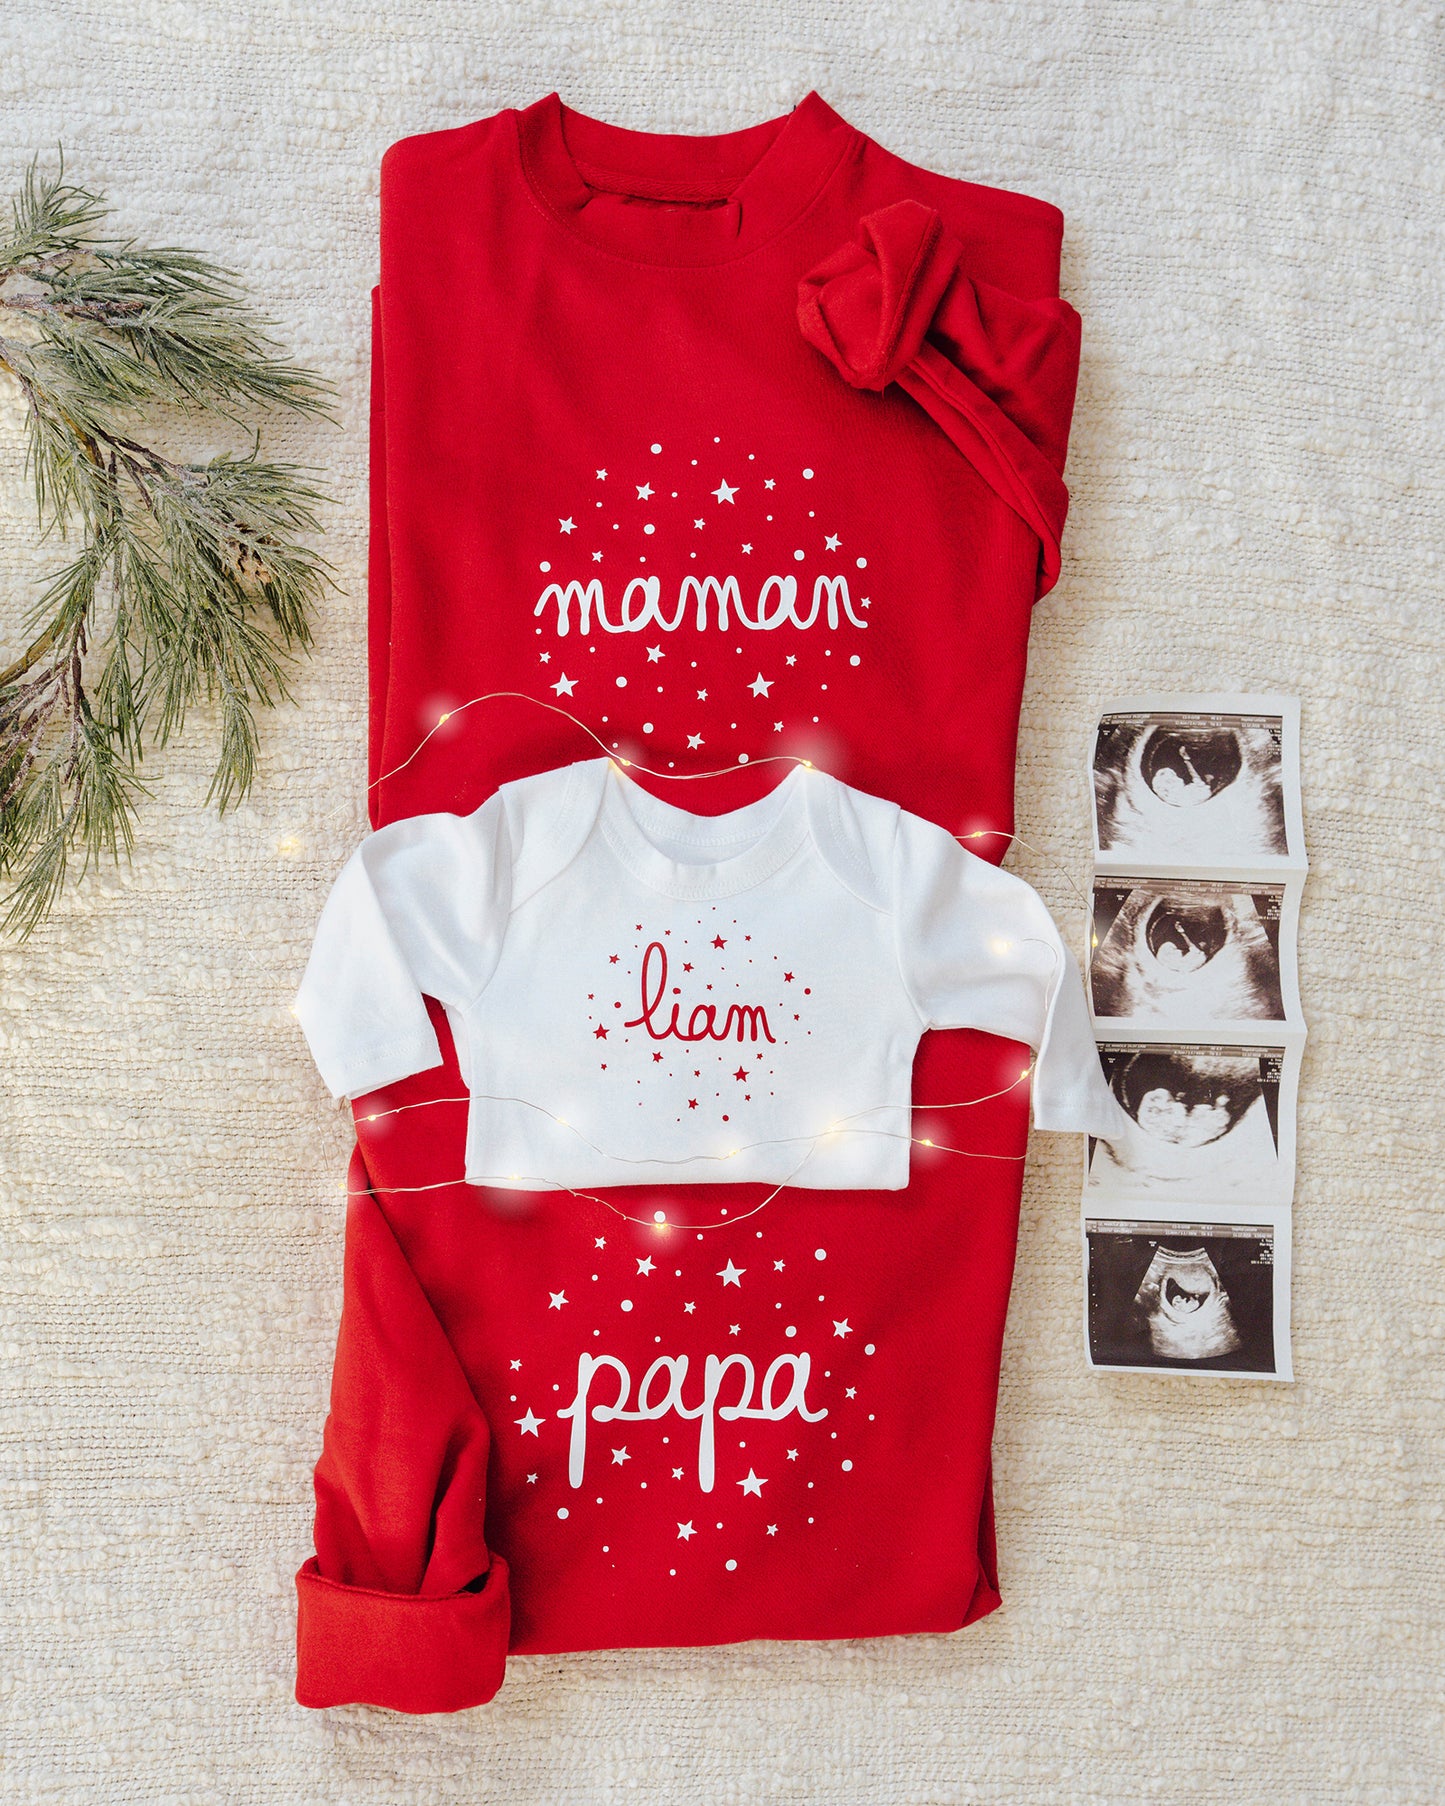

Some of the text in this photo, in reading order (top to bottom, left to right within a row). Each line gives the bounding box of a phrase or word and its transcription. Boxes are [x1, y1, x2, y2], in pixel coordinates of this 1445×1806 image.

[534, 575, 868, 637] maman
[624, 942, 776, 1043] liam
[557, 1352, 828, 1493] papa
